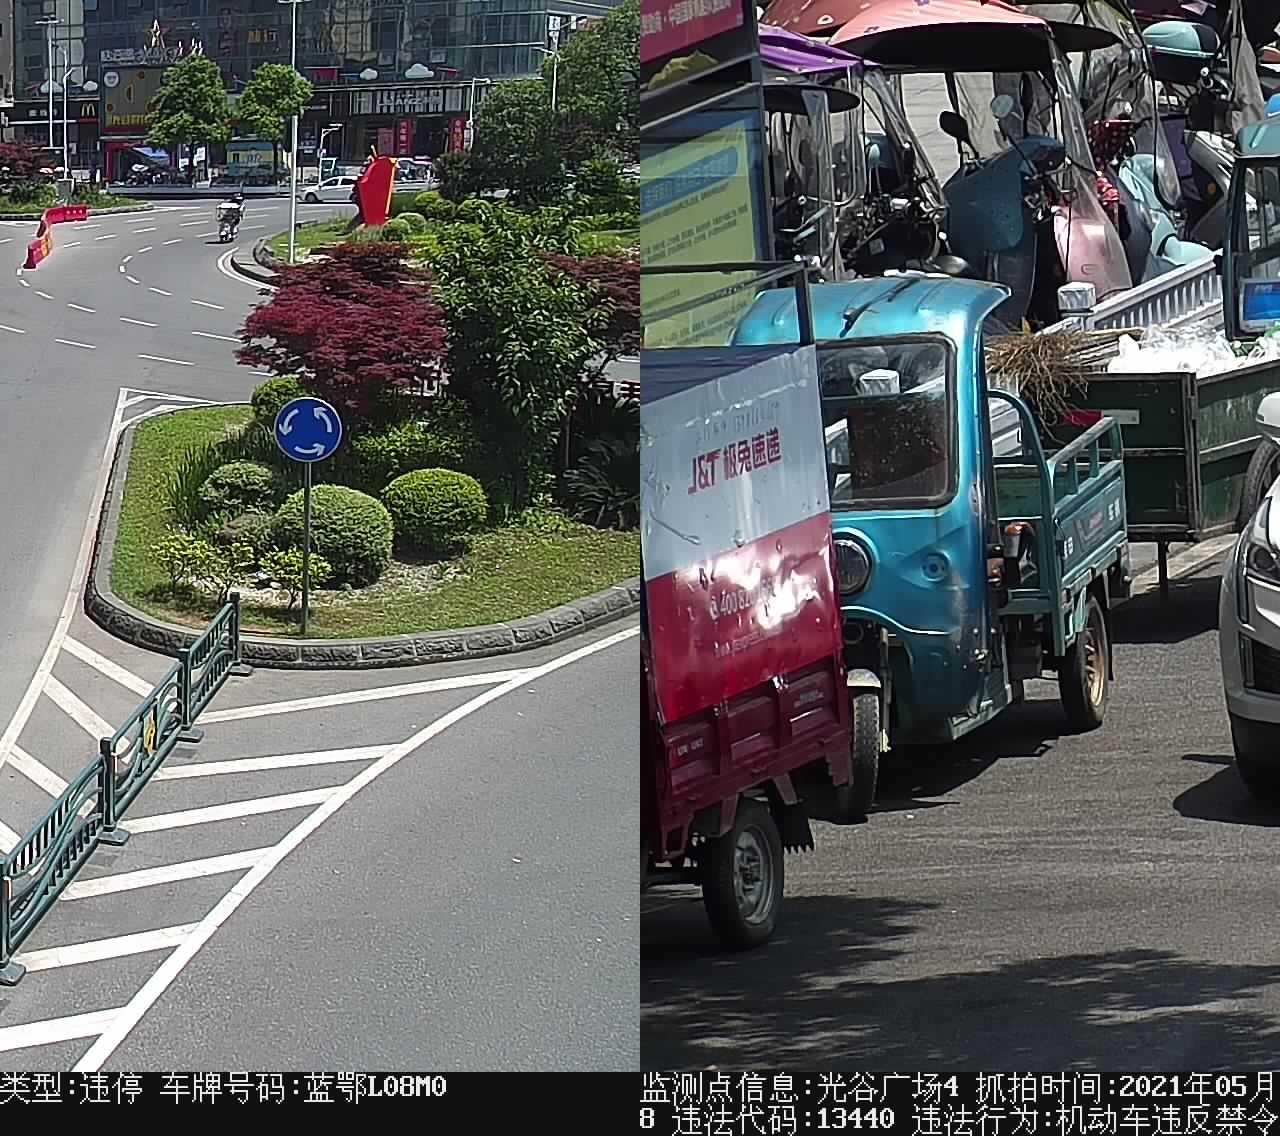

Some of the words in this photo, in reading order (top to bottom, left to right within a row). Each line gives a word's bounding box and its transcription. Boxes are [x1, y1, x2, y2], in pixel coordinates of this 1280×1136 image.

[687, 448, 721, 495] J&T
[723, 426, 782, 481] 极兔速递
